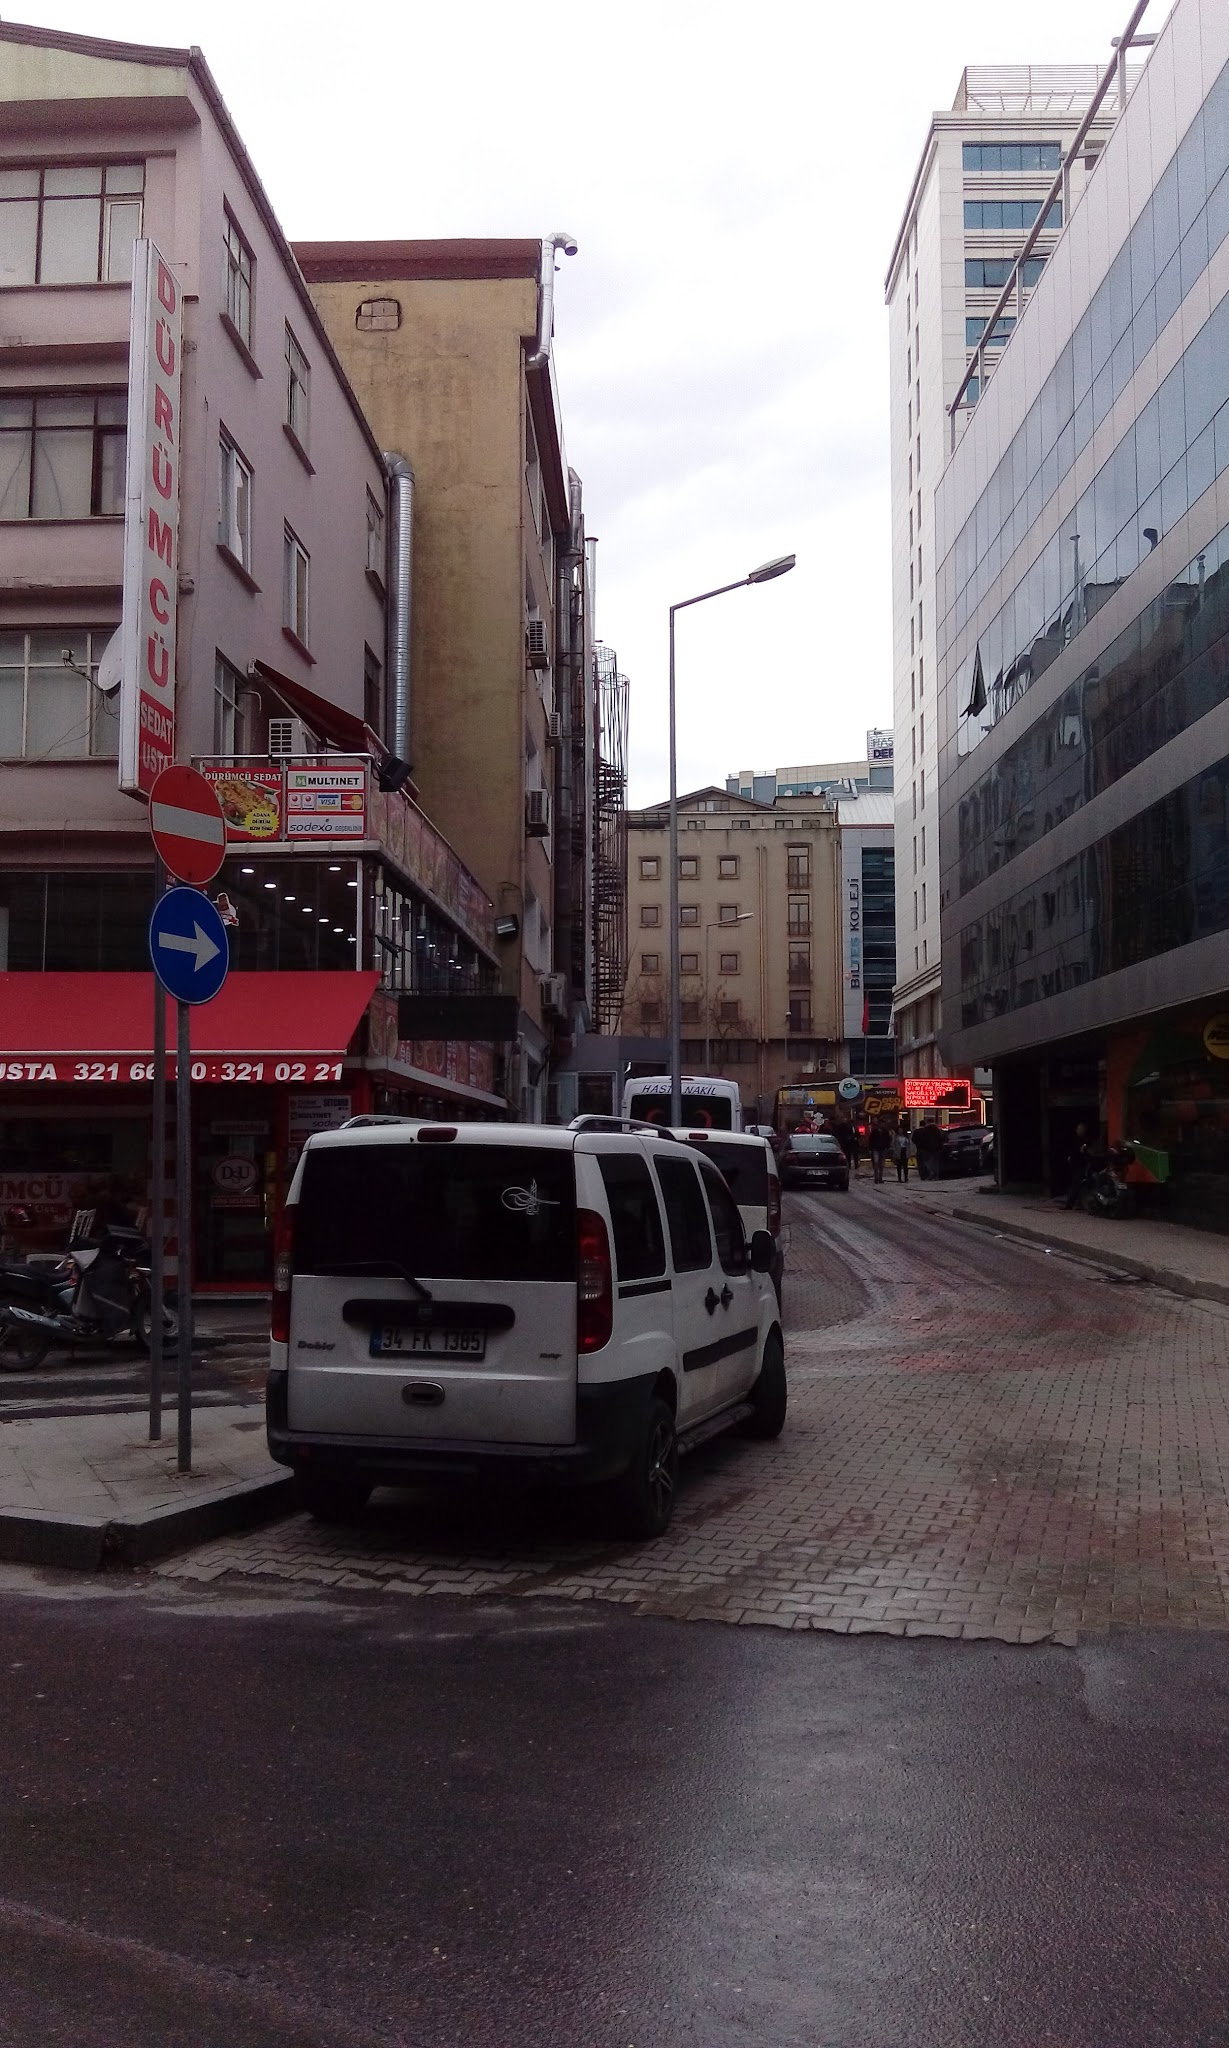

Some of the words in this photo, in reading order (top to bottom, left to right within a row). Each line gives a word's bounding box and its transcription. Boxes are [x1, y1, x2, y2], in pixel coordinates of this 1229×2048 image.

[147, 258, 176, 688] DÜRÜMCÜ
[141, 701, 173, 745] SEDAT
[254, 773, 282, 782] SEDAT
[308, 777, 360, 786] MULTINET
[289, 822, 333, 832] sodexo
[73, 1062, 120, 1081] 321
[275, 1063, 306, 1081] 02
[313, 1063, 344, 1081] 21
[642, 1084, 681, 1095] HAST
[684, 1085, 718, 1096] NAKİL
